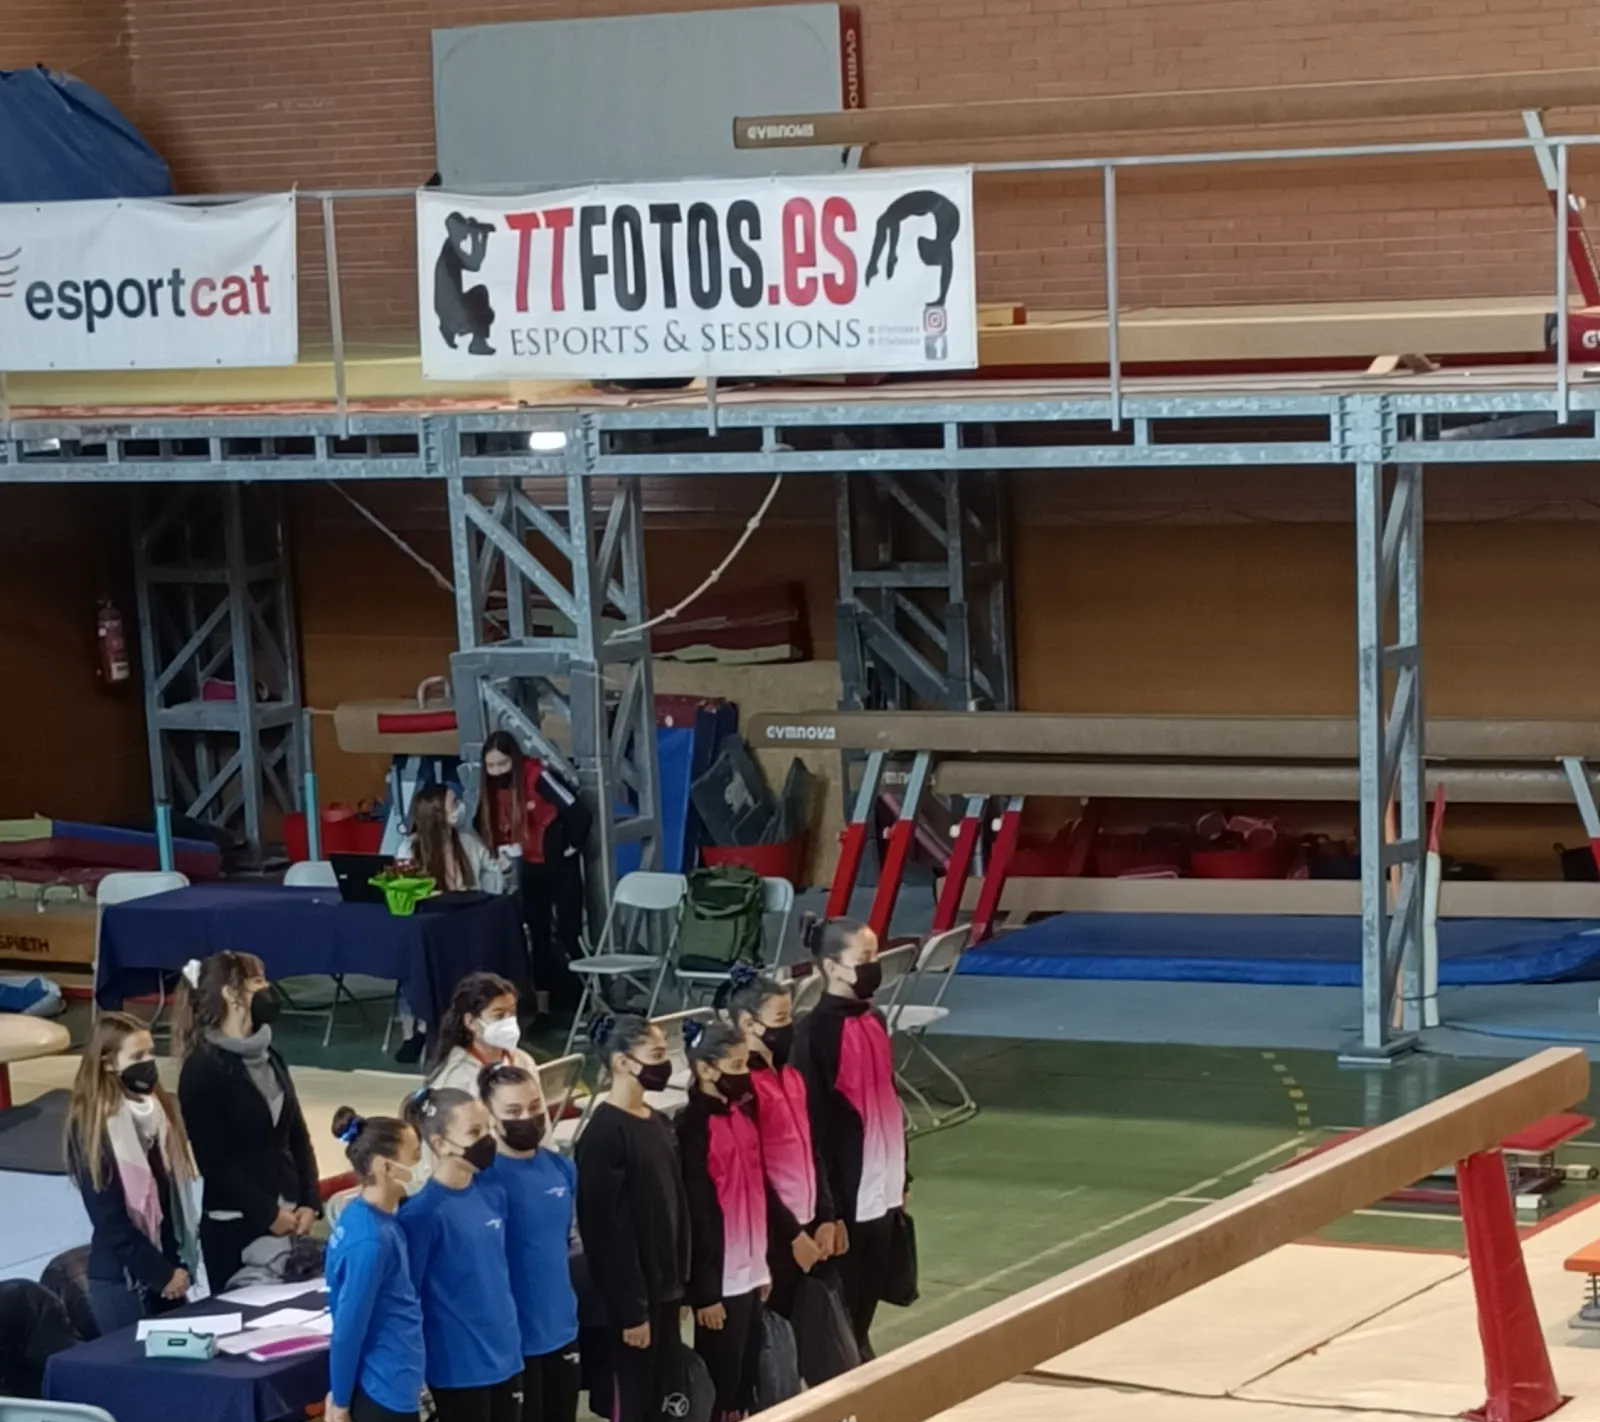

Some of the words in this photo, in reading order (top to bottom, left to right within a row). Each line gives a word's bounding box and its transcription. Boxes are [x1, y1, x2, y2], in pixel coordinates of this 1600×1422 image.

[846, 28, 860, 110] GYMNO
[504, 196, 858, 314] TTFOTOS.es
[25, 264, 271, 333] esportcat
[510, 325, 650, 356] ESPORTS
[663, 319, 692, 353] &
[701, 318, 861, 352] SESSIONS
[766, 725, 836, 740] GYMNOVA
